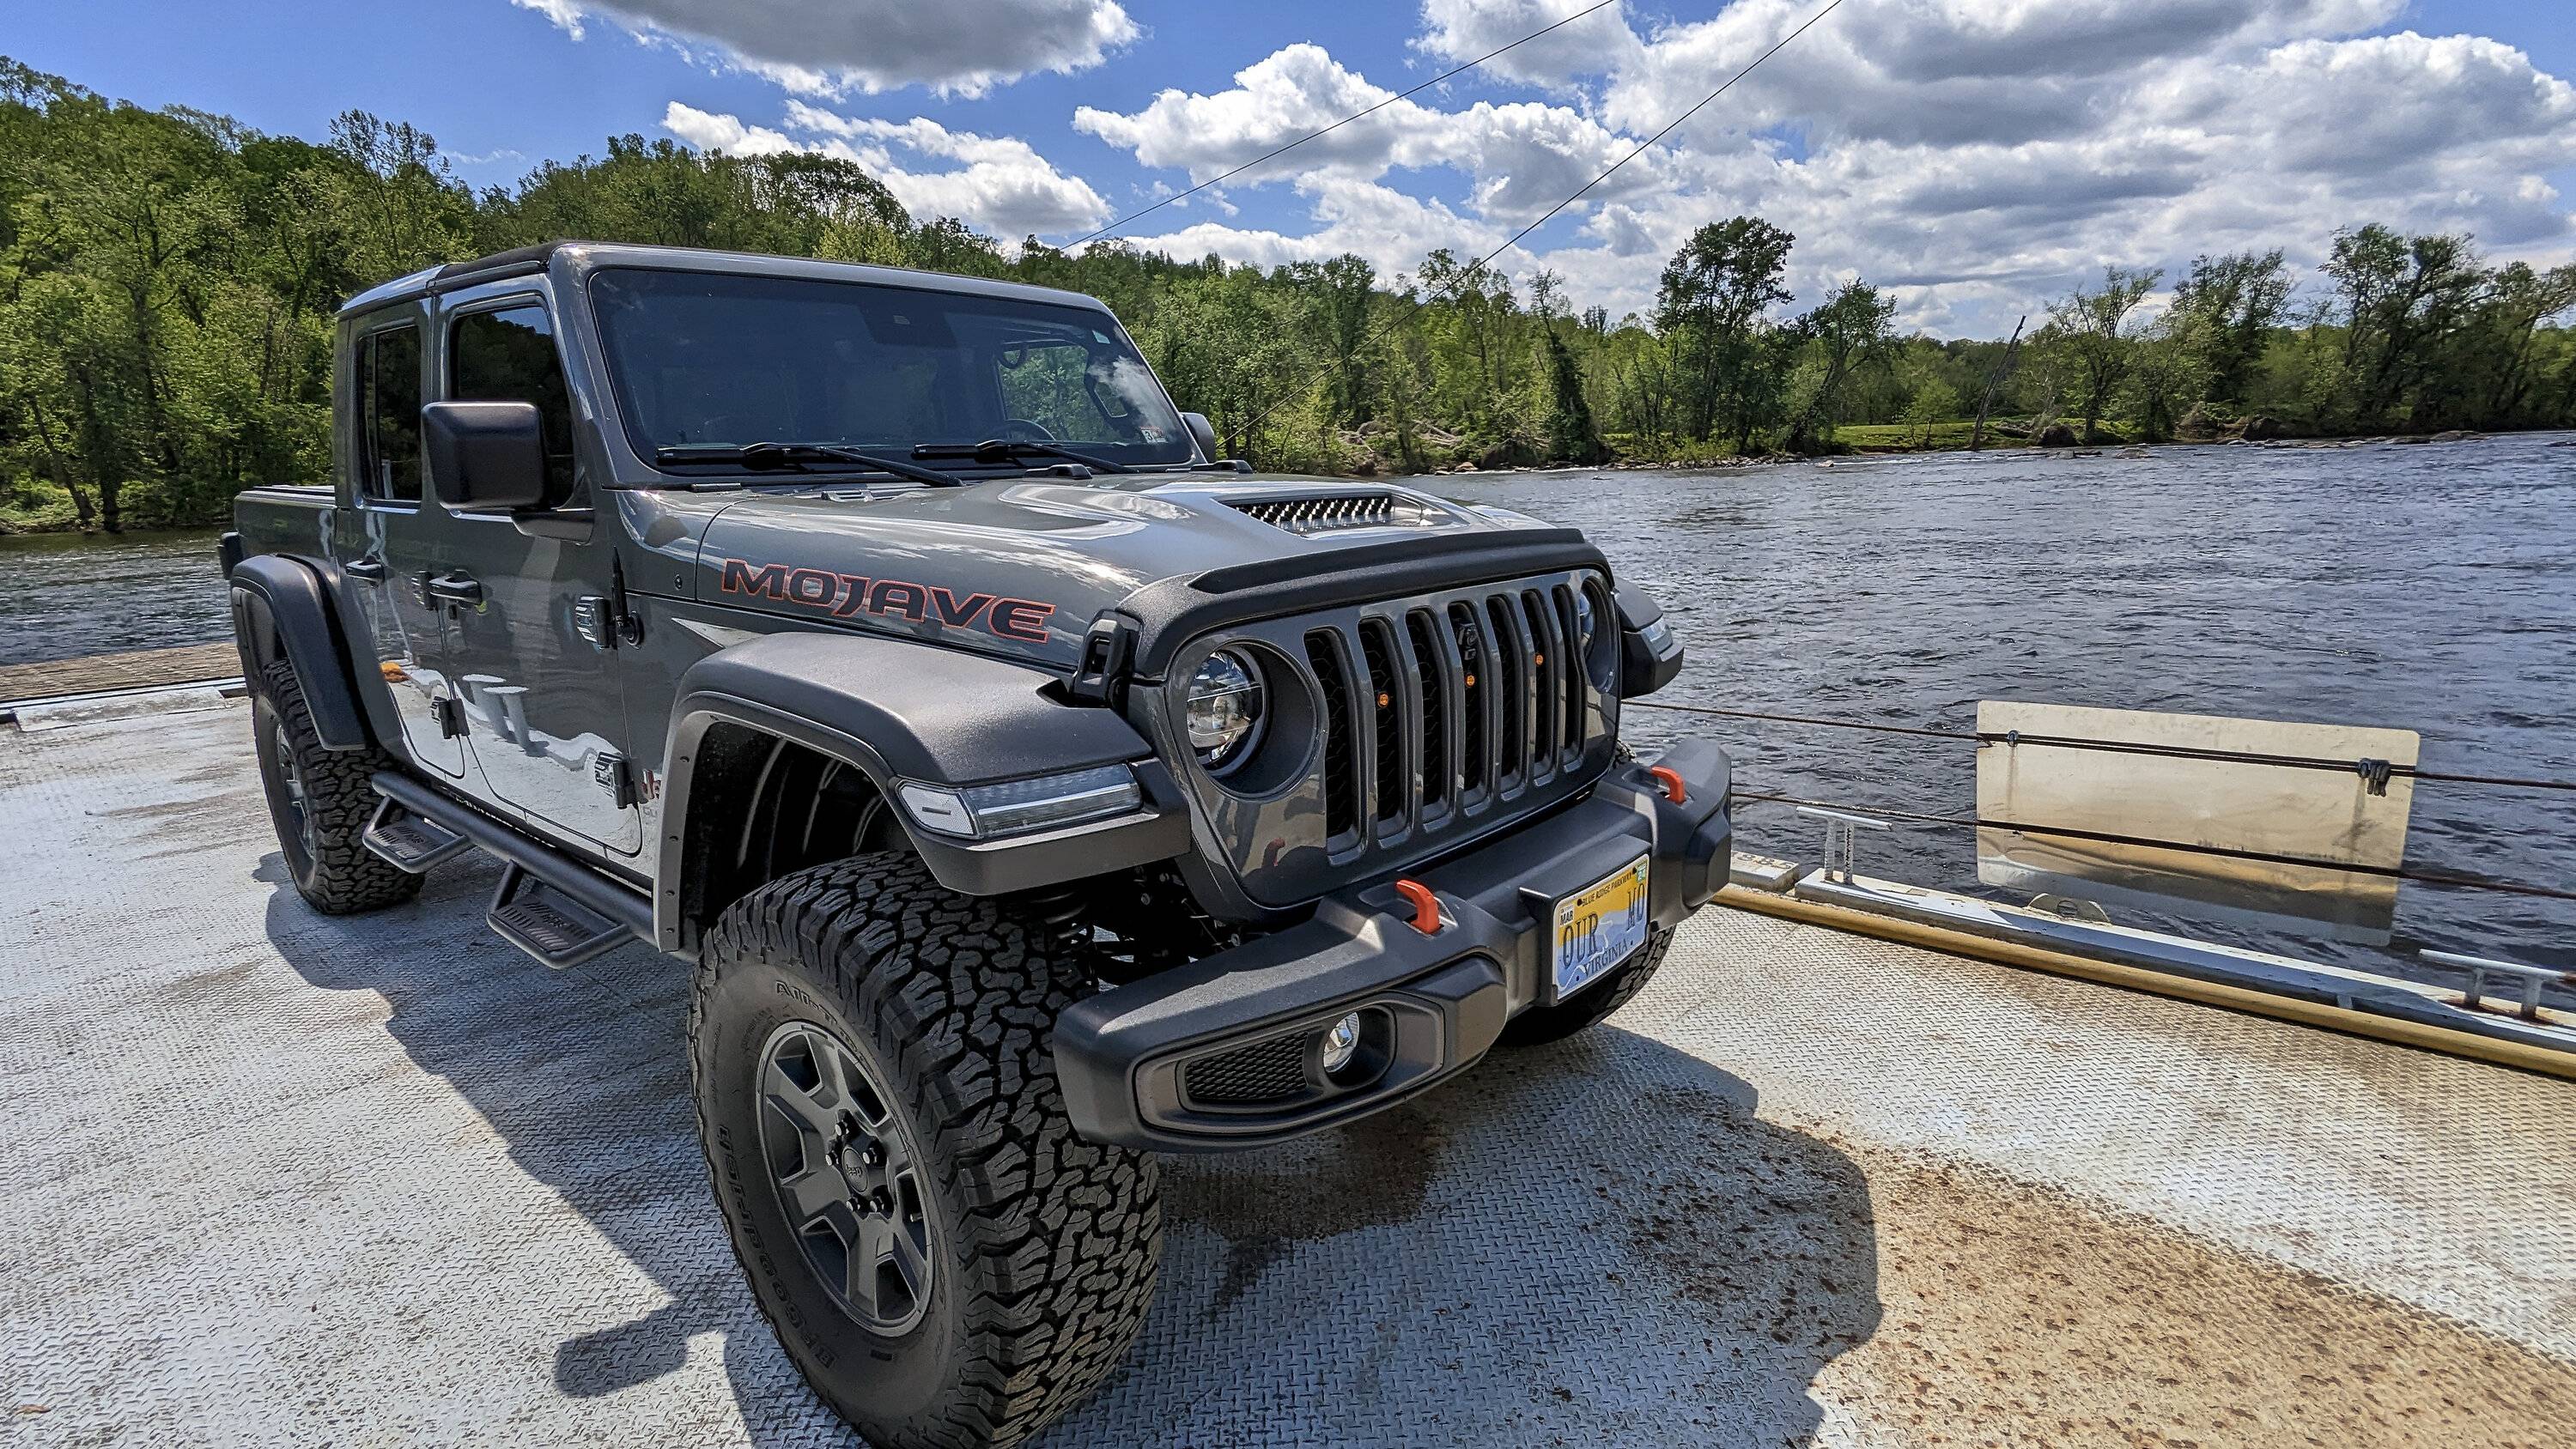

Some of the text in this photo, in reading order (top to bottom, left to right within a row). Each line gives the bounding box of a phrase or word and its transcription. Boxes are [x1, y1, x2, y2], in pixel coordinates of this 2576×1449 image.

[721, 558, 1056, 644] MOJAVE
[1560, 910, 1573, 925] MAR
[1563, 912, 1599, 970] OUR
[1584, 938, 1628, 977] VIRGINIA
